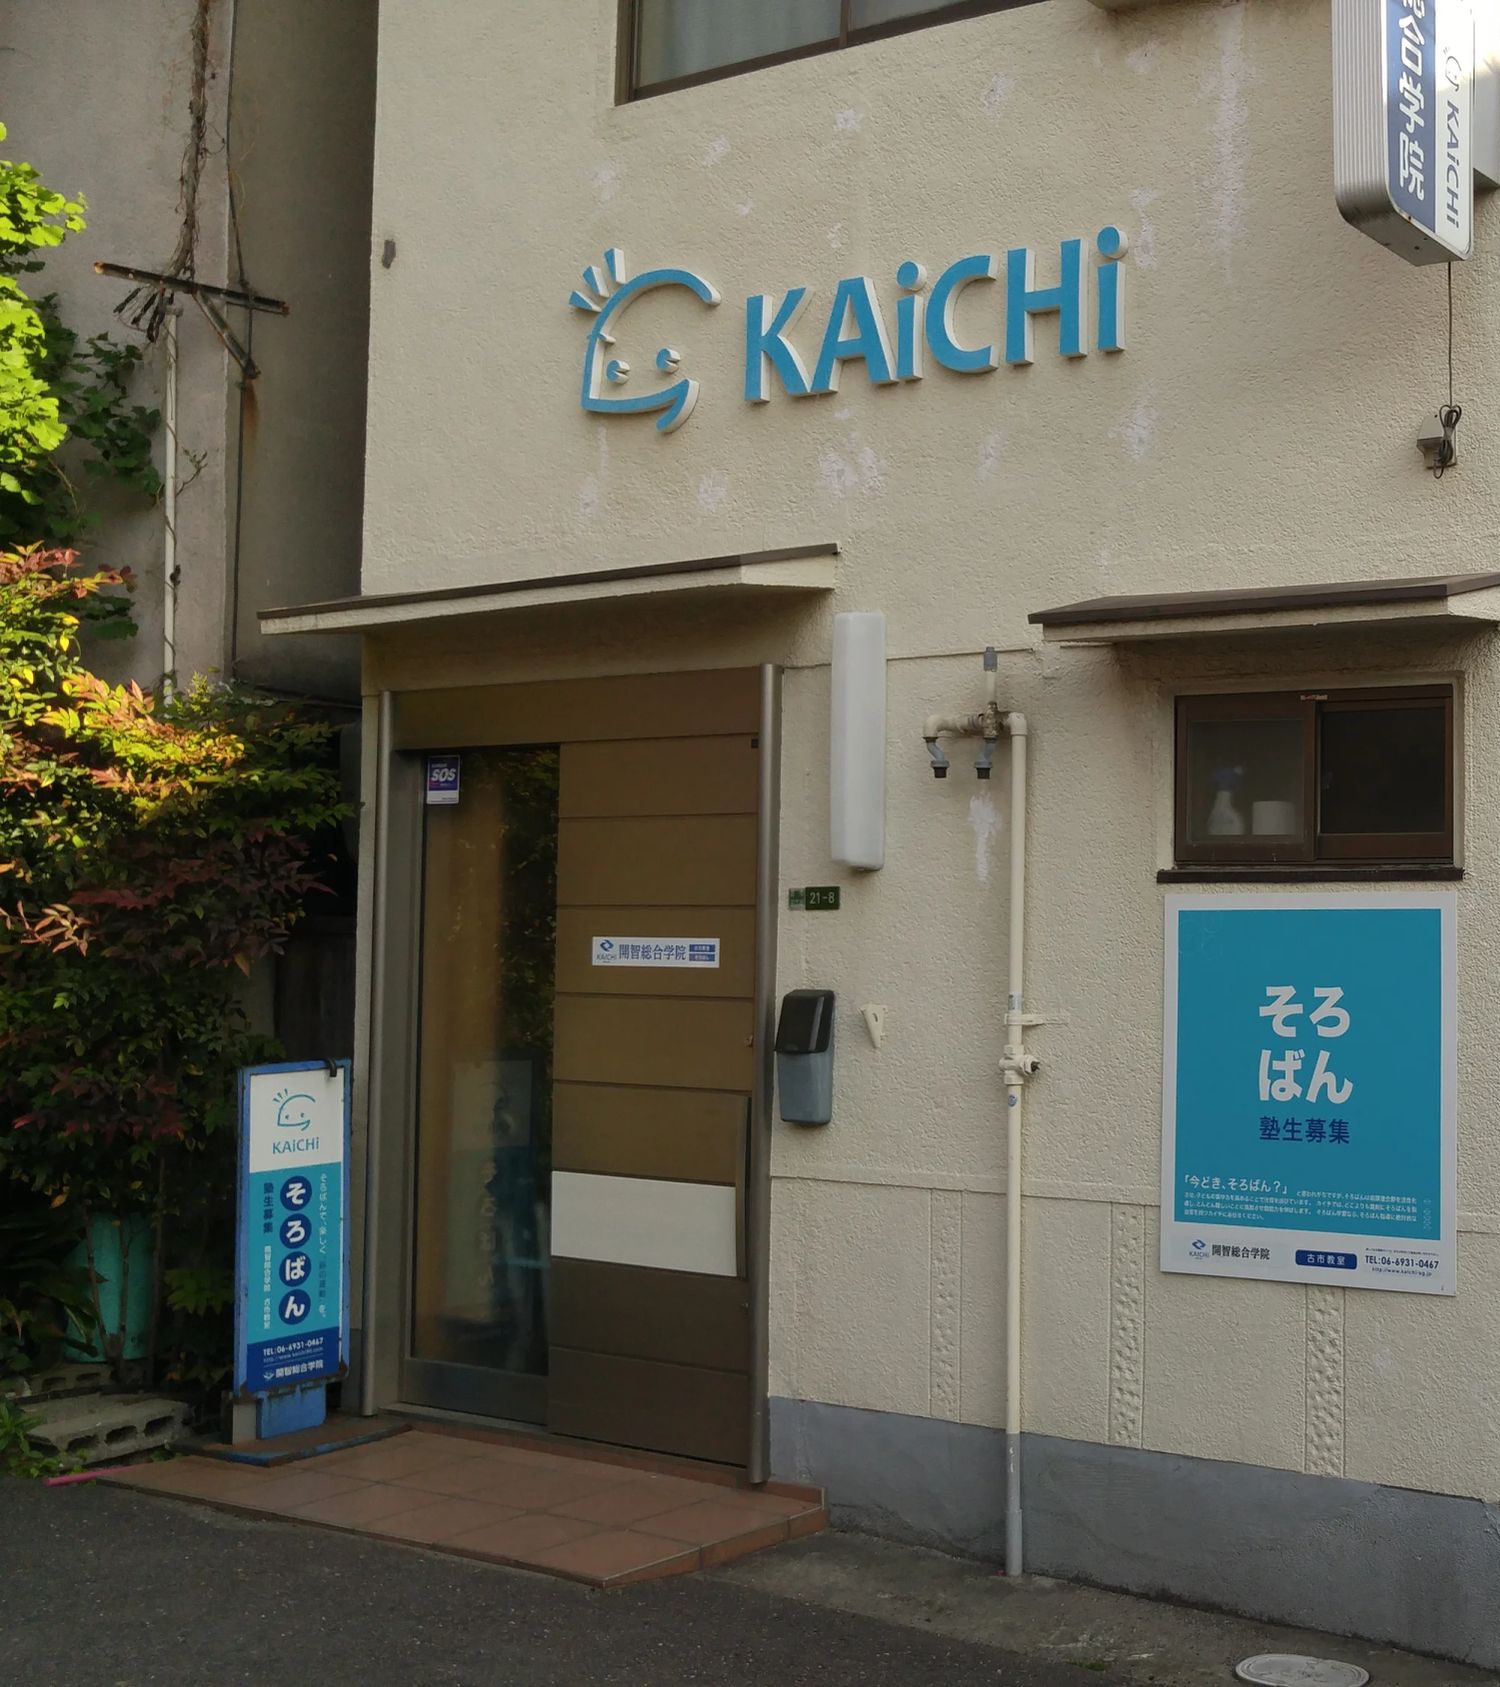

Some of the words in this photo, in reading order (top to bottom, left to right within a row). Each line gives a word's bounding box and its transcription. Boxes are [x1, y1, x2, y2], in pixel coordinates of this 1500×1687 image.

[431, 767, 457, 782] SOS
[809, 891, 835, 905] 21-8
[618, 943, 687, 961] 開智総合学院
[1258, 985, 1351, 1038] そろ
[1258, 1048, 1354, 1105] ばん
[1258, 1115, 1351, 1145] 塾生募集
[284, 1181, 307, 1320] そろばん
[1211, 1244, 1271, 1261] 開智総合学院
[1306, 1253, 1346, 1266] 古市教室
